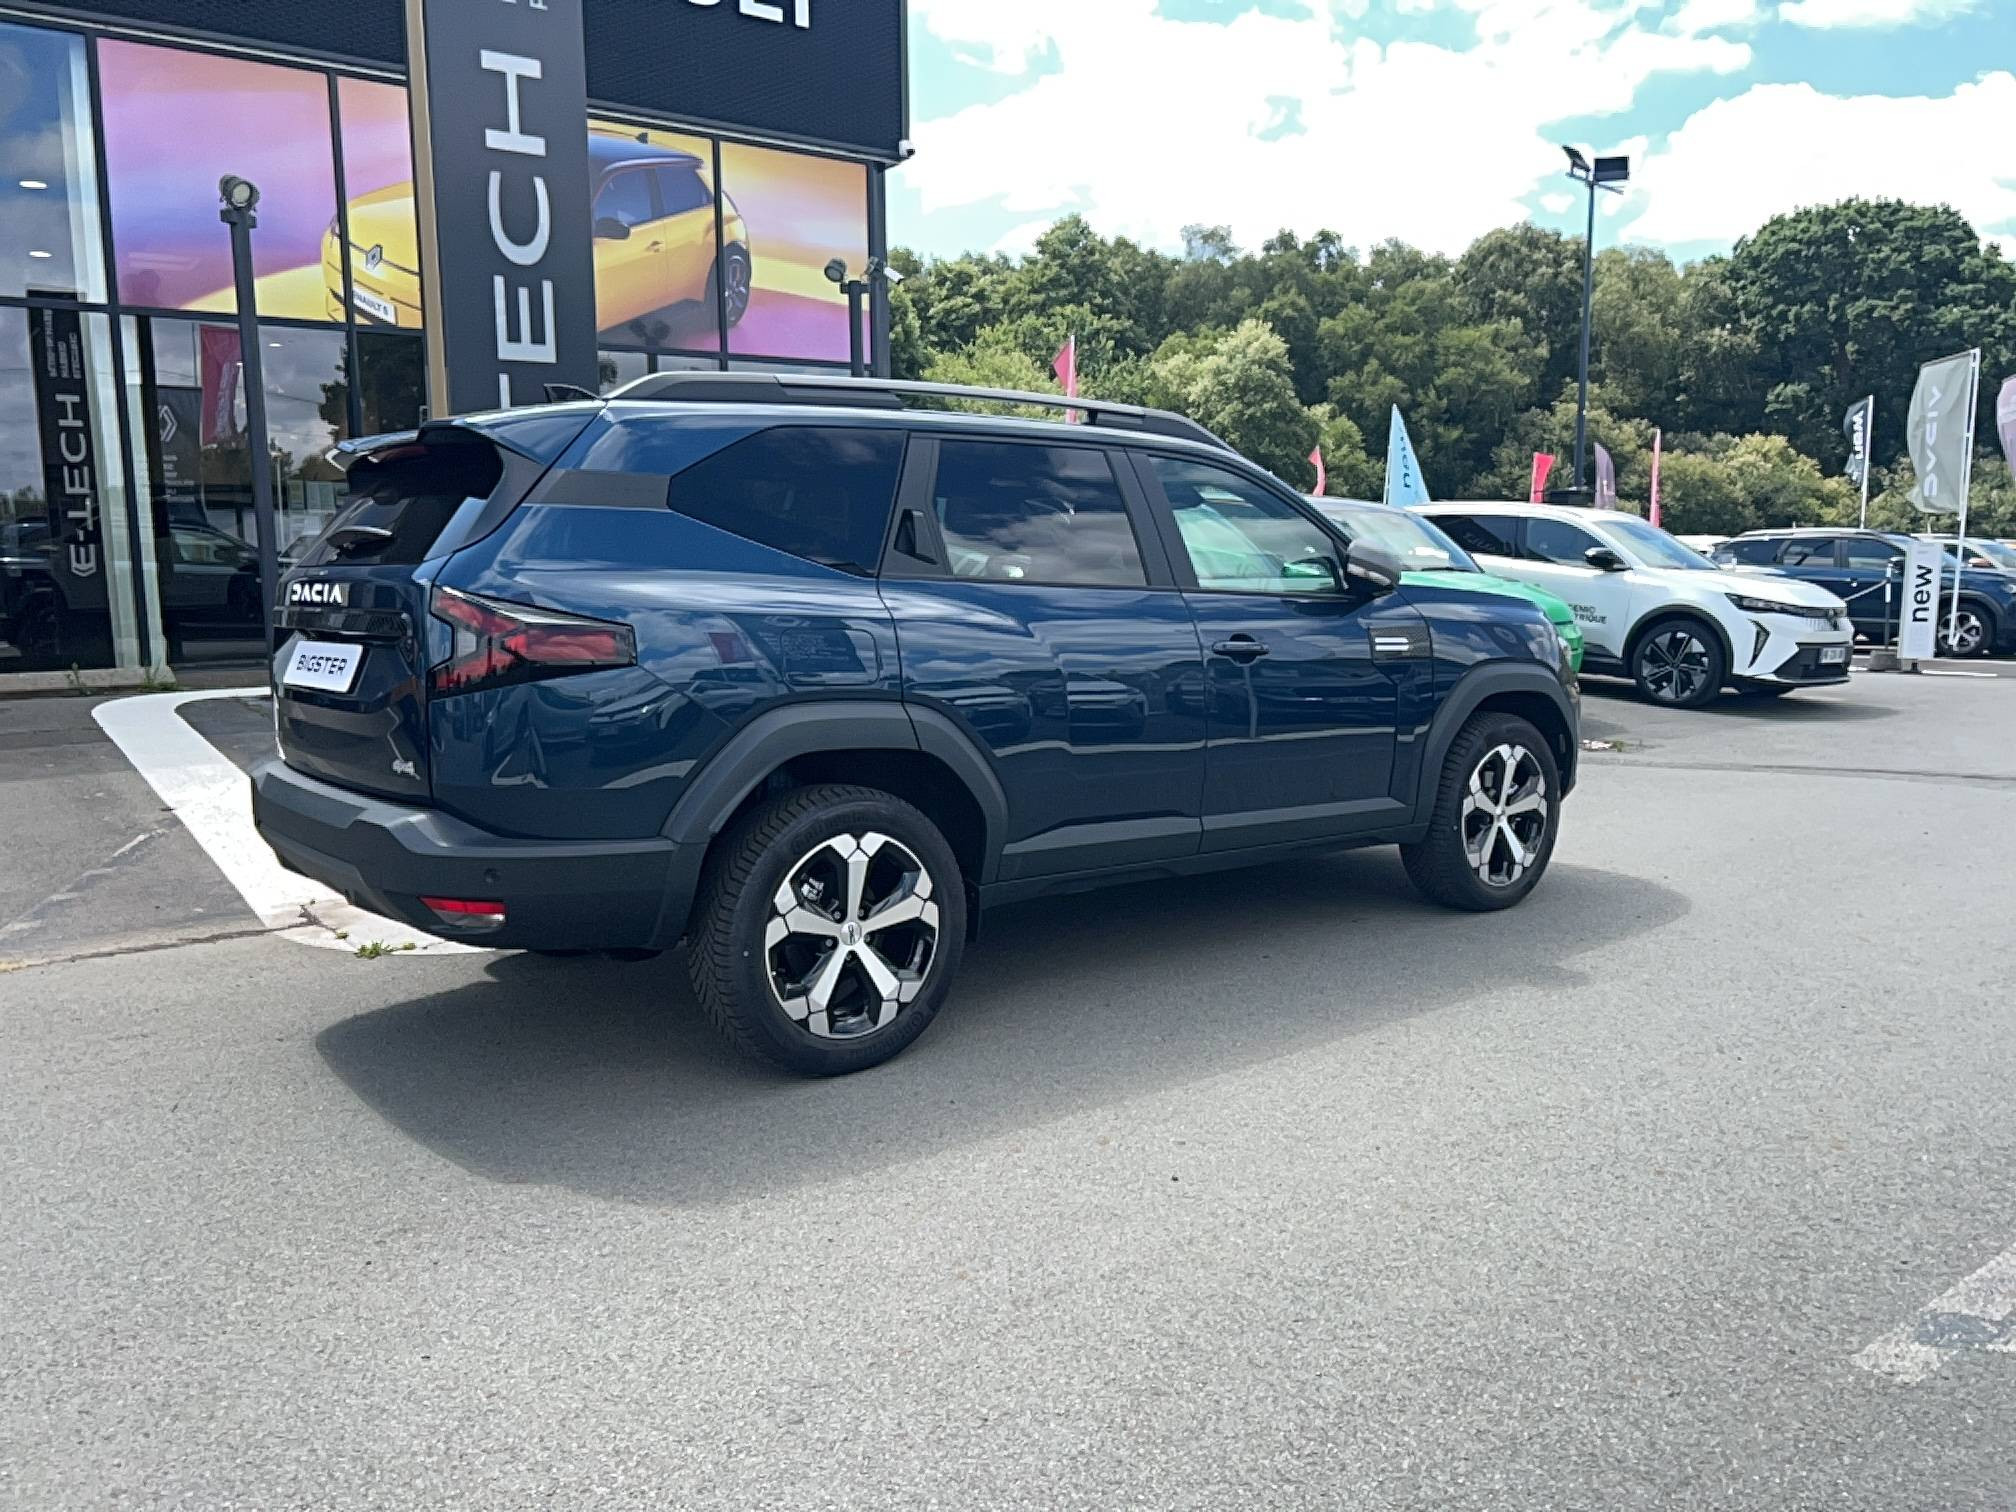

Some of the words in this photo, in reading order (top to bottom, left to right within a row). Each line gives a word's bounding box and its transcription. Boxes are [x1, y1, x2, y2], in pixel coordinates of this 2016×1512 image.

[291, 583, 342, 604] DACIA
[1912, 564, 1933, 623] new
[296, 654, 348, 675] BIGSTER
